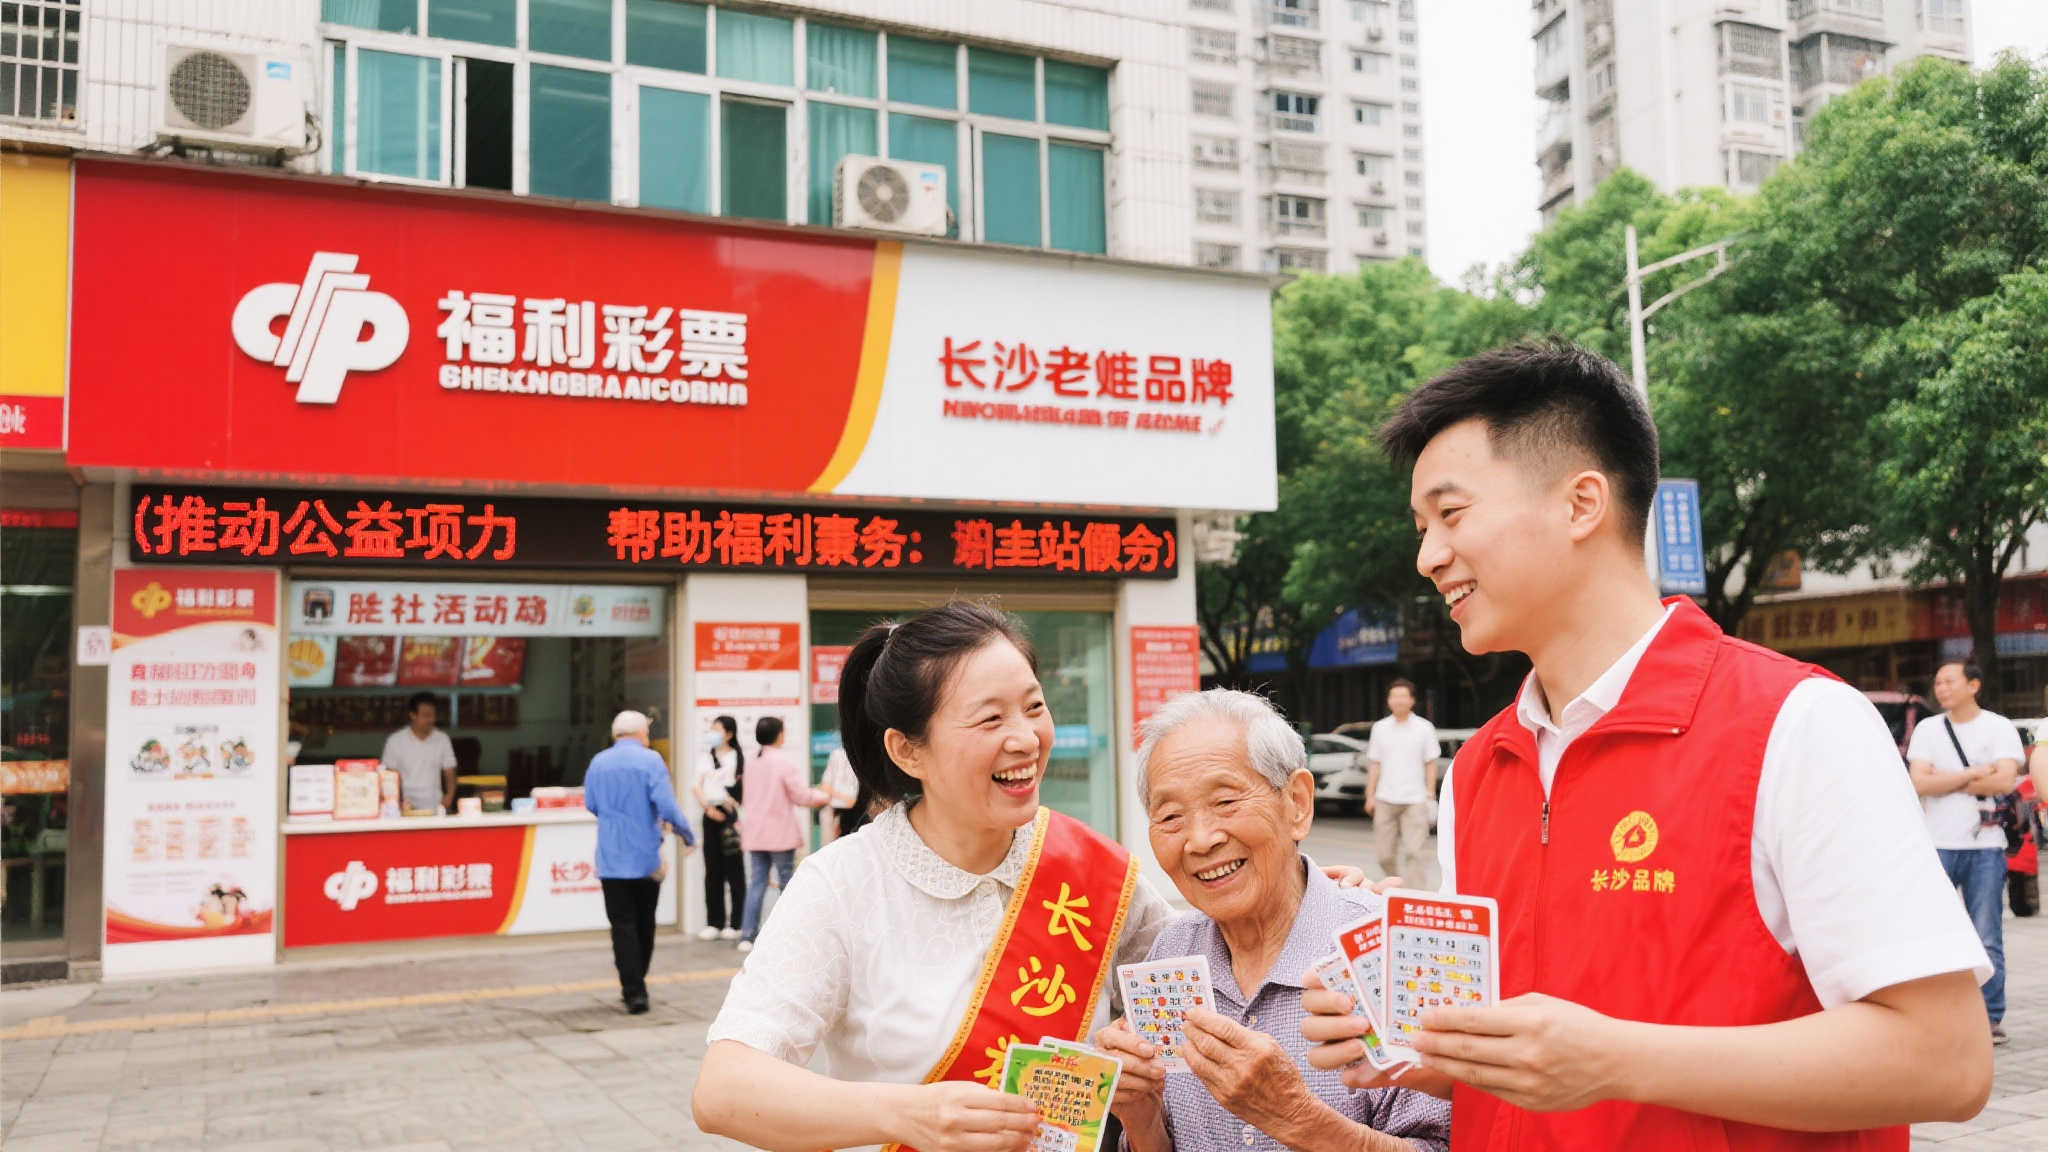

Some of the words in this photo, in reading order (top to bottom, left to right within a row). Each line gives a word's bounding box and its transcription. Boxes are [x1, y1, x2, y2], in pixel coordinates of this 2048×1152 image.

[437, 289, 749, 379] 福利彩票
[1590, 868, 1676, 894] 长沙品牌
